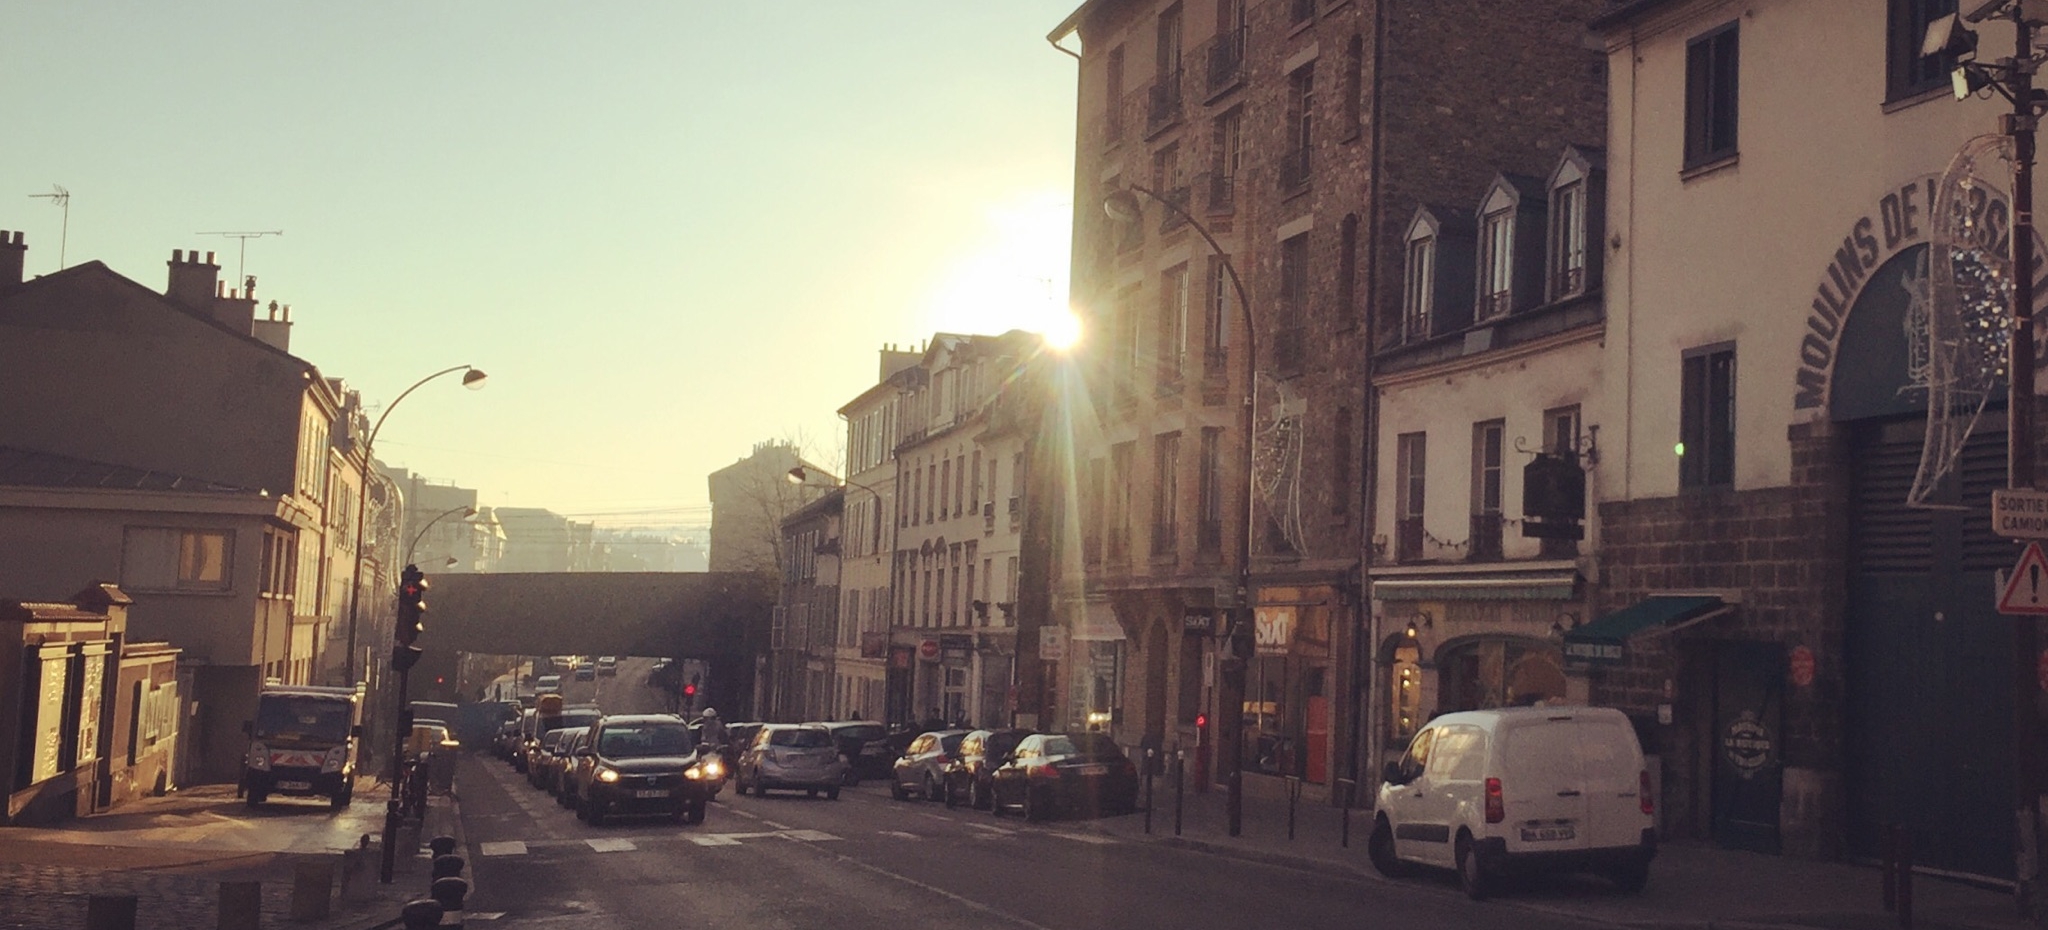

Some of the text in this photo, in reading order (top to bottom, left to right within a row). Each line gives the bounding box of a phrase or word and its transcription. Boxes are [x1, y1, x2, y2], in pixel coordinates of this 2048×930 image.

[1795, 216, 1879, 410] MOULINS
[1880, 183, 1918, 249] DE
[1999, 496, 2044, 513] SORTIE
